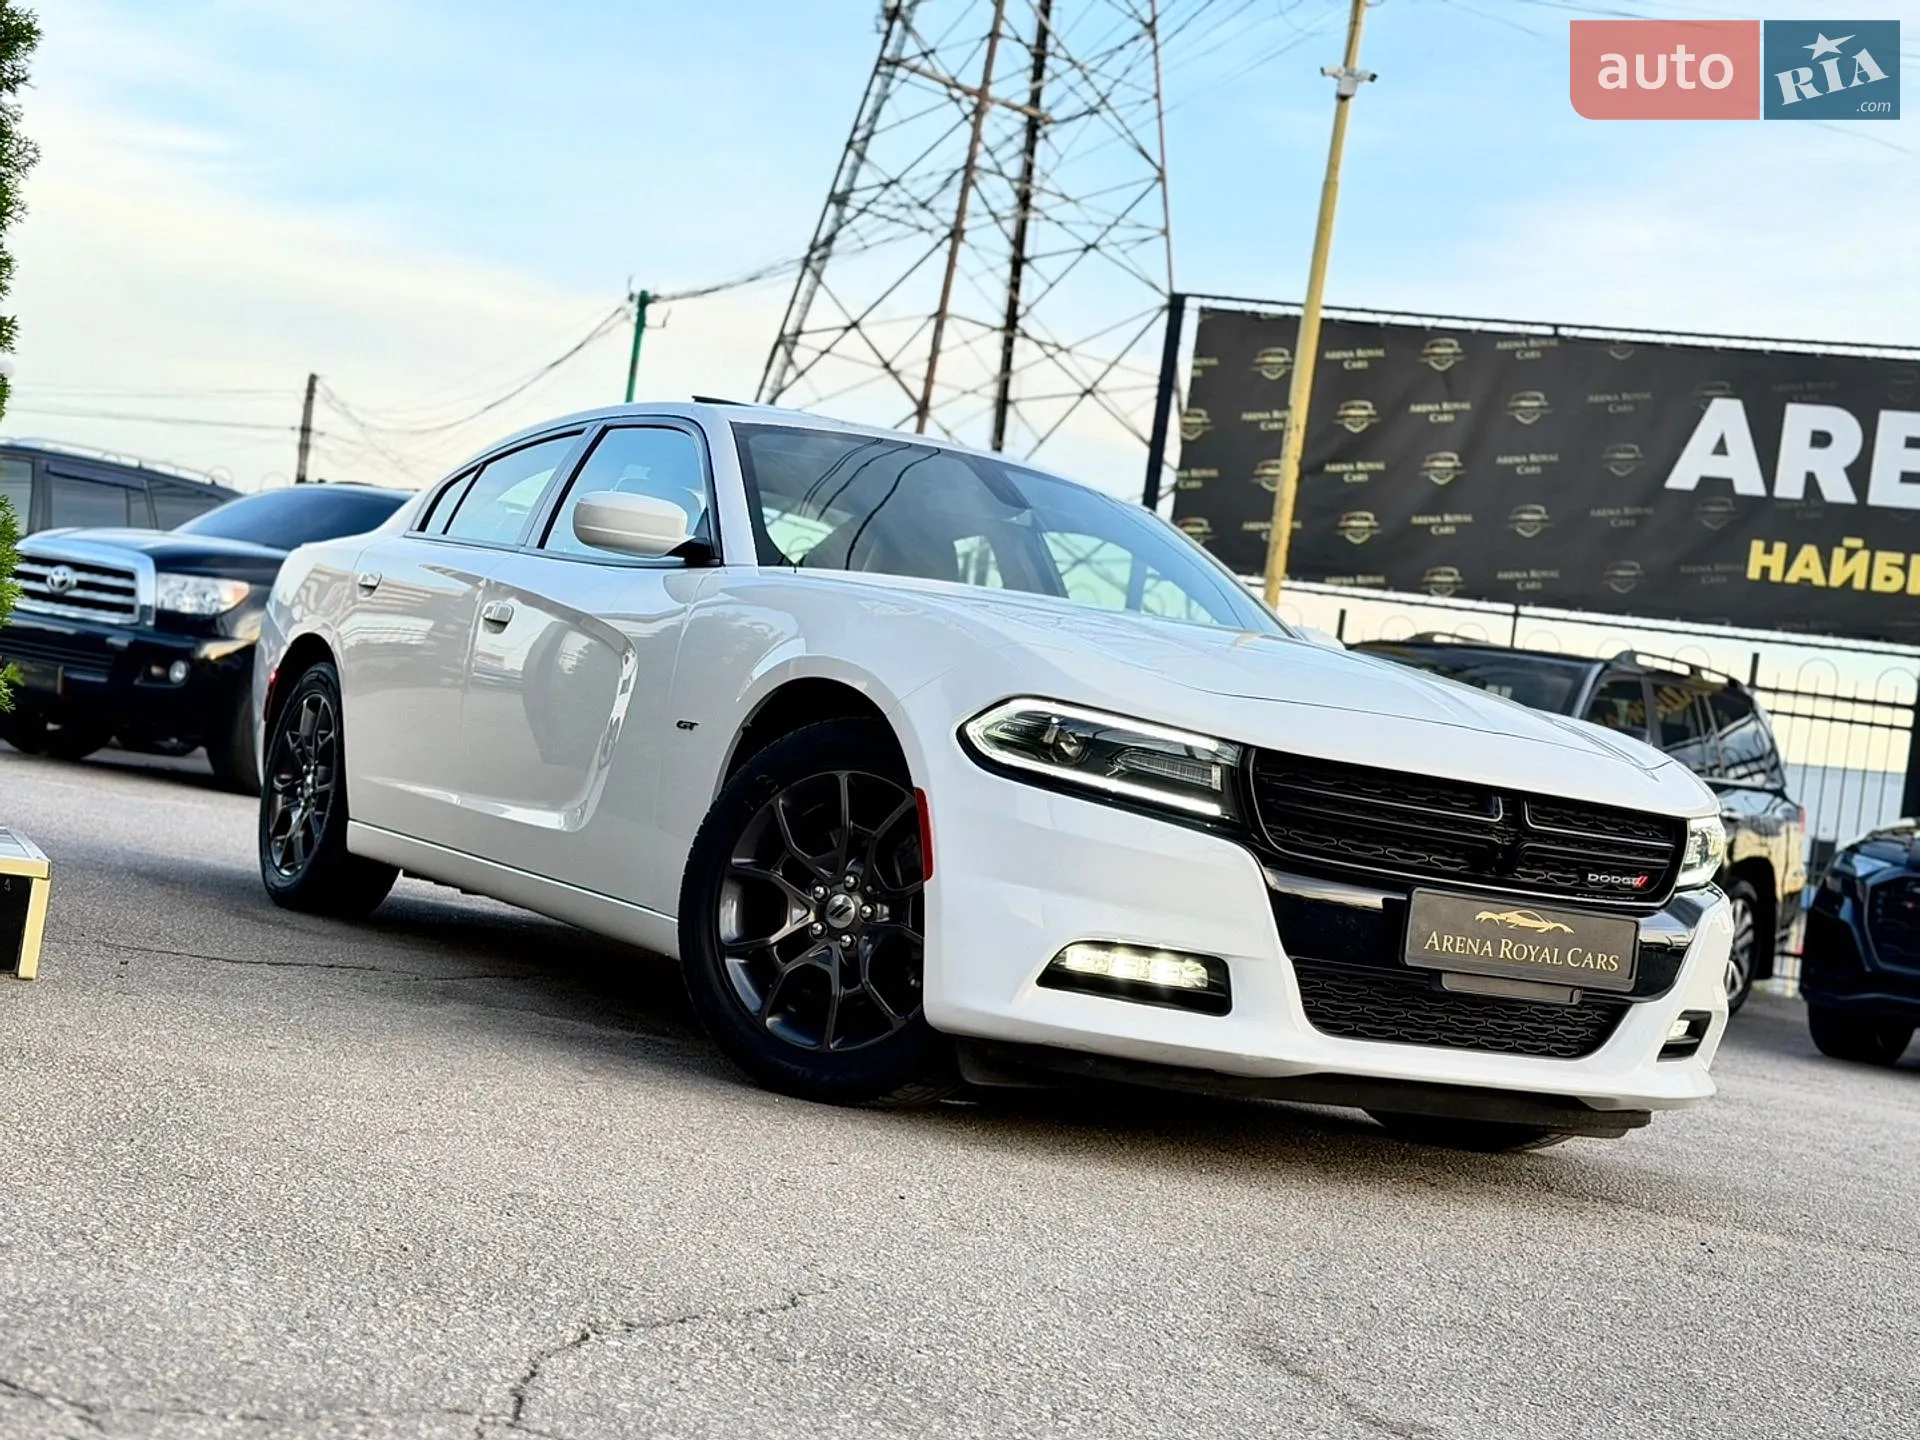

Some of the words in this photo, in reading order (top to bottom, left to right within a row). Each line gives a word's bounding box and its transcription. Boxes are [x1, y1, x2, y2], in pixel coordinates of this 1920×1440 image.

[1343, 360, 1369, 370] CARS
[1429, 414, 1455, 423] CARS
[1343, 473, 1369, 483] CARS
[1431, 525, 1456, 534] CARS
[676, 720, 699, 731] GT
[1424, 931, 1492, 957] ARENA
[1499, 938, 1562, 965] ROYAL
[1567, 946, 1620, 973] CARS
